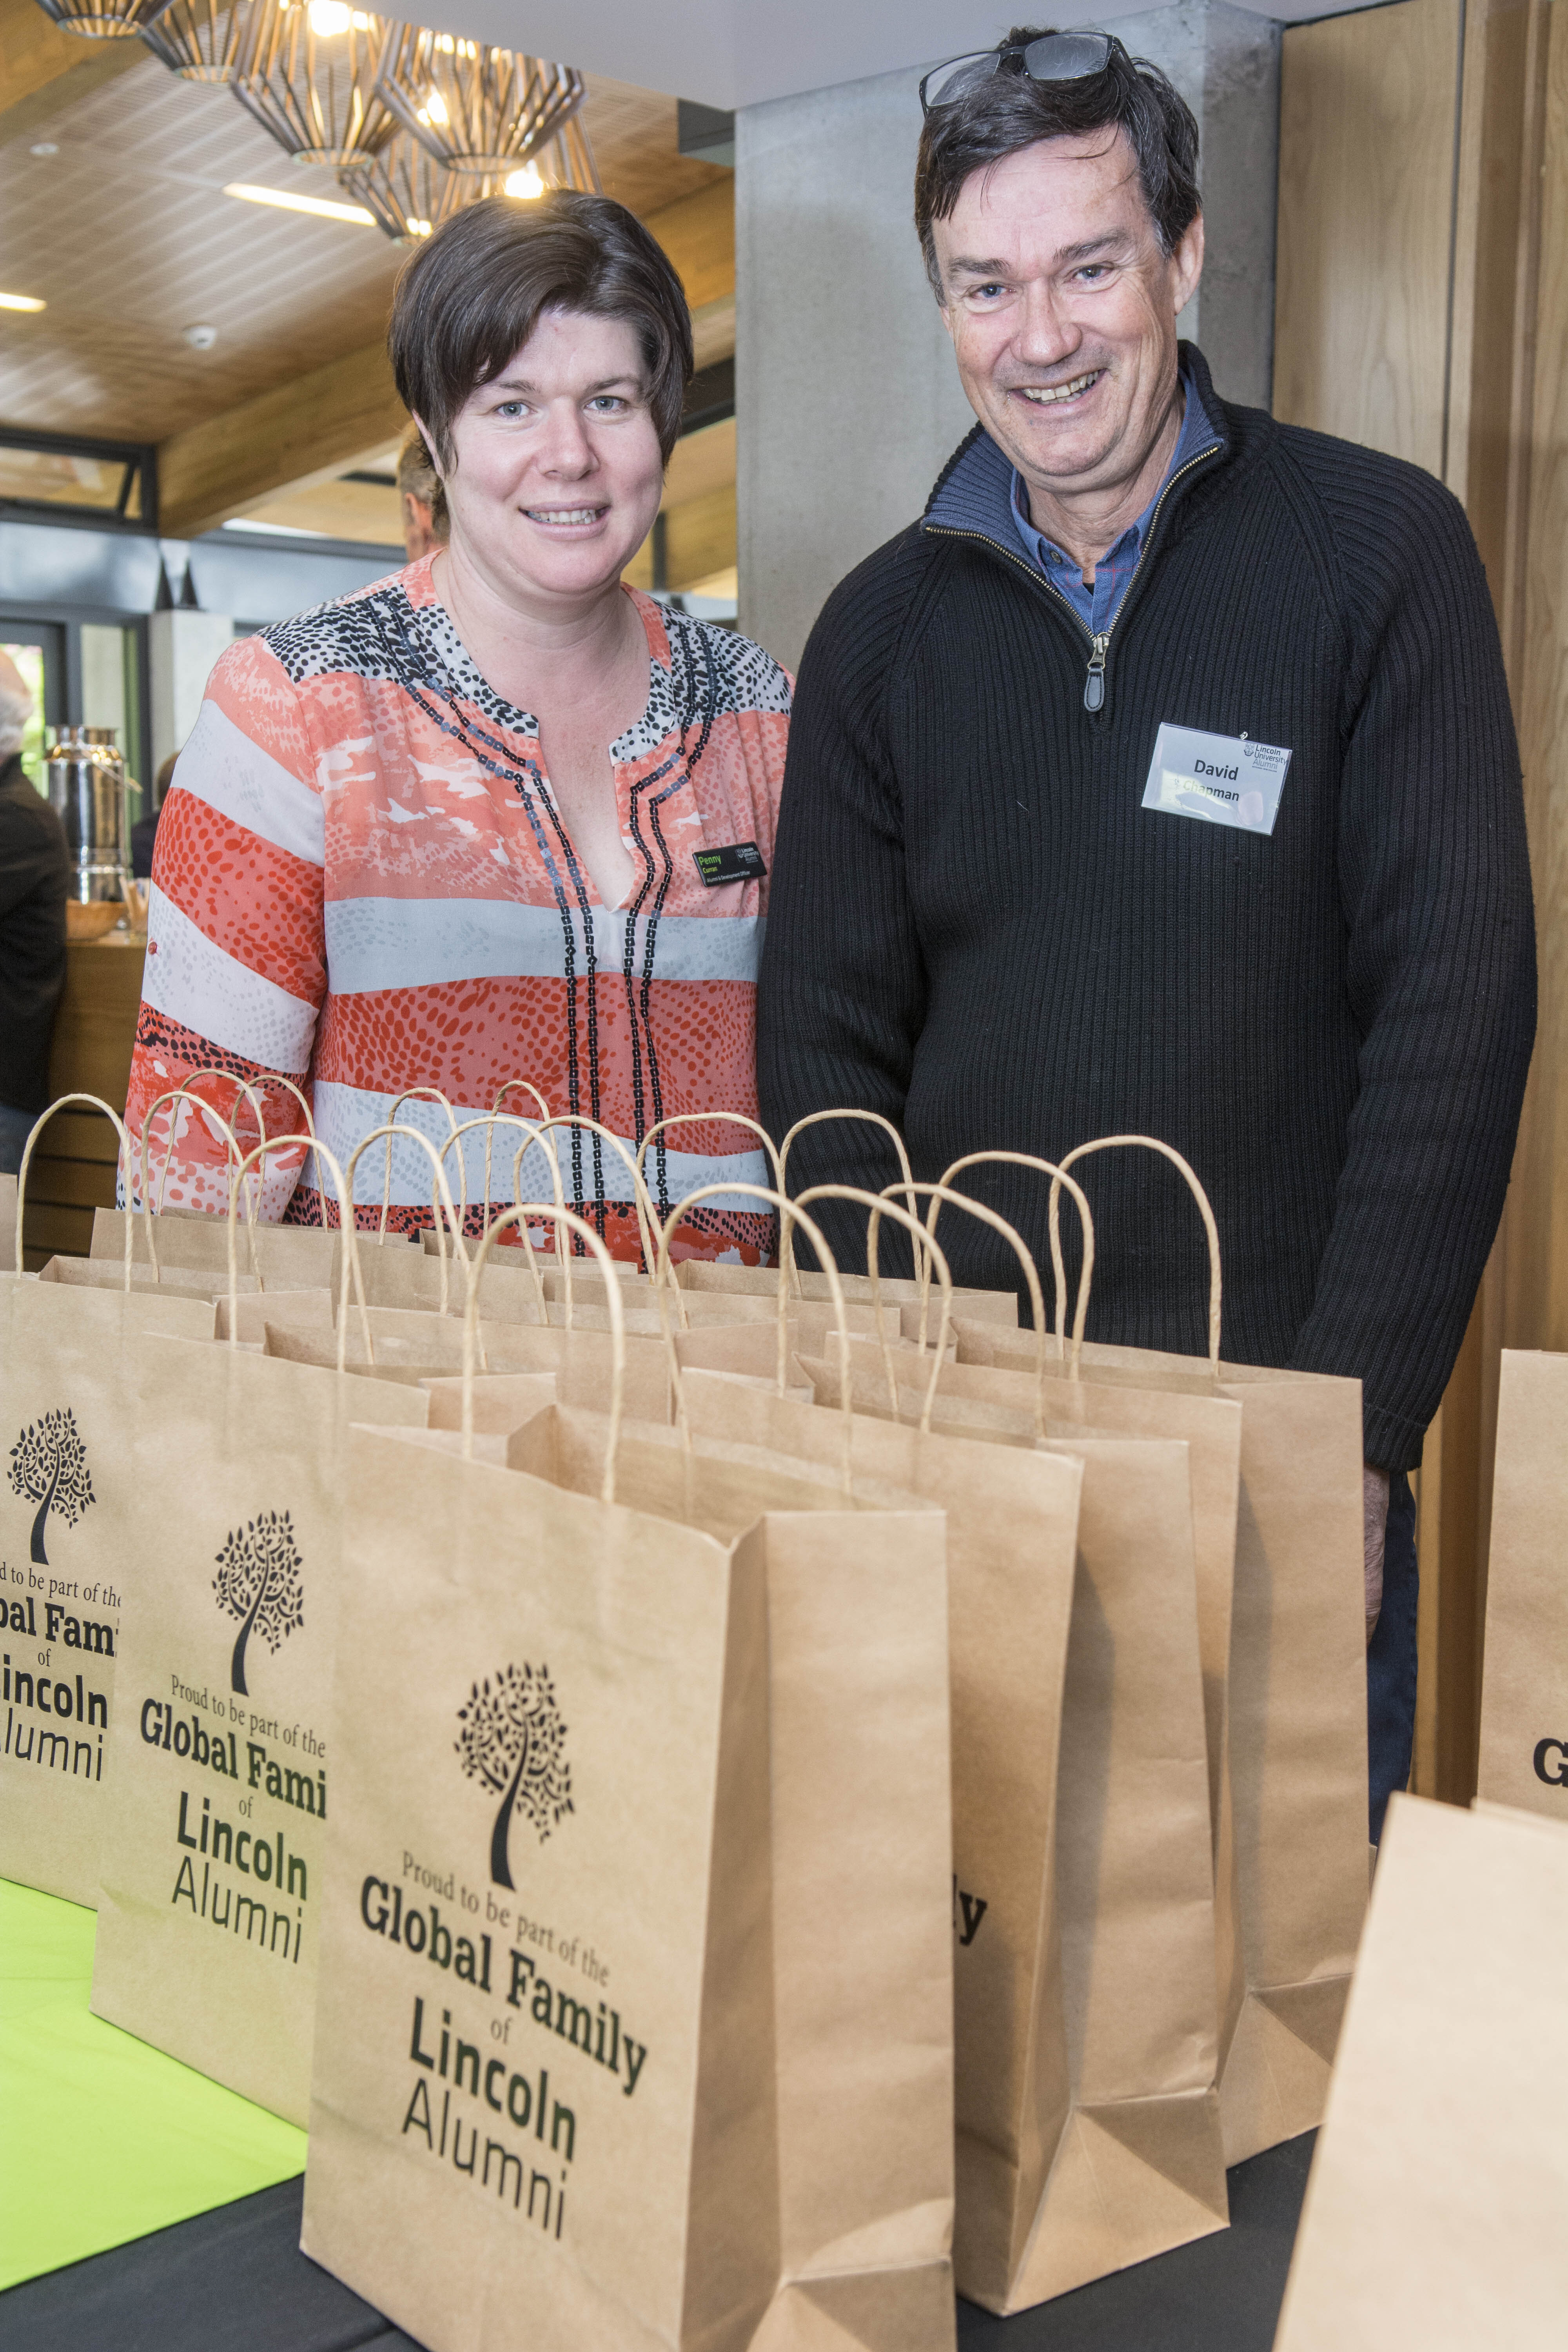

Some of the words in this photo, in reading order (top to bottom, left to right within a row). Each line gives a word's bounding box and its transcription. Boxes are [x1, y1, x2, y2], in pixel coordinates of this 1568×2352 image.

[1194, 759, 1239, 780] David
[1253, 758, 1278, 769] Alumni
[1254, 751, 1287, 765] University
[1256, 745, 1281, 755] Lincoln
[1183, 780, 1239, 801] Chapman
[698, 855, 721, 866] Penny
[11, 1567, 24, 1584] to
[29, 1568, 44, 1590] be
[48, 1579, 78, 1598] part
[83, 1583, 100, 1602] of
[38, 1648, 51, 1667] of
[44, 1602, 119, 1658] Fam
[0, 1653, 107, 1729] incoln
[171, 1675, 208, 1710] Proud
[212, 1695, 225, 1717] to
[229, 1698, 245, 1726] be
[250, 1714, 279, 1740] part
[283, 1724, 300, 1748] of
[303, 1730, 326, 1758] the
[0, 1708, 103, 1781] lumni
[140, 1698, 239, 1780] Global
[239, 1796, 254, 1819] of
[177, 1791, 307, 1901] Lincoln
[171, 1855, 302, 1964] Alumni
[402, 1850, 455, 1901] Proud
[460, 1884, 479, 1914] to
[485, 1891, 510, 1927] be
[516, 1914, 554, 1952] part
[558, 1935, 580, 1967] of
[581, 1946, 610, 1987] the
[361, 1875, 492, 1994] Global
[506, 1948, 649, 2096] Family
[490, 2017, 512, 2045] of
[409, 1995, 576, 2163] Lincoln
[401, 2077, 566, 2241] Alumni
